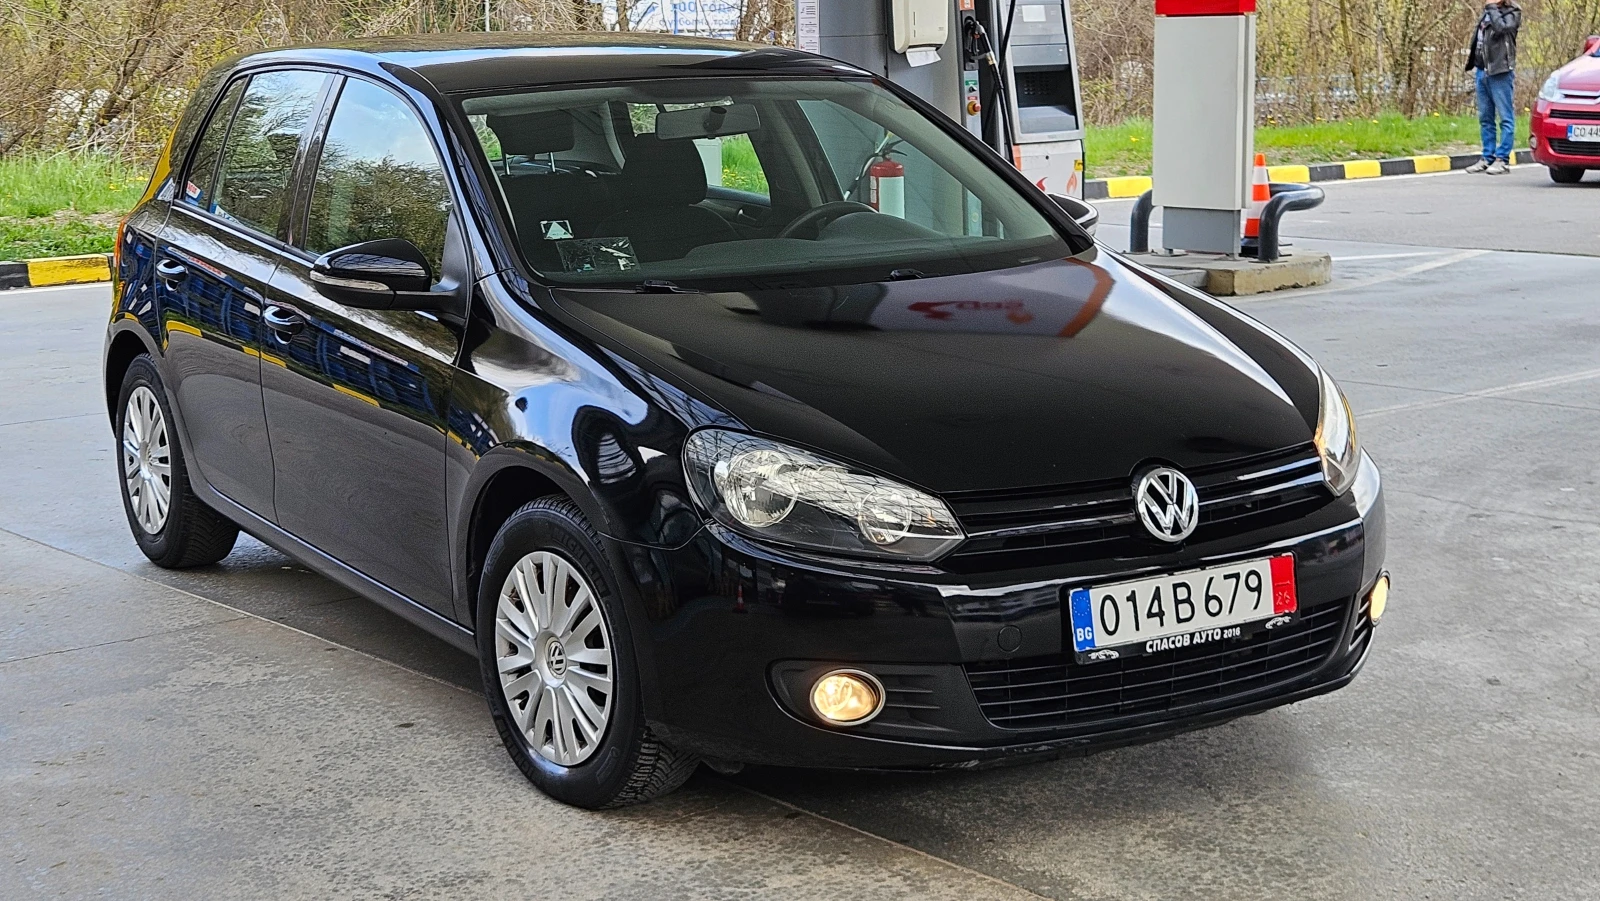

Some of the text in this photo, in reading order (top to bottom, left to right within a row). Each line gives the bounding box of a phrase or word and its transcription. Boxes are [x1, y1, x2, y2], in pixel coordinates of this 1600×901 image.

[1588, 126, 1600, 137] 44
[1076, 627, 1093, 642] BG
[1145, 626, 1241, 653] СПАСОВ АУТО 2016
